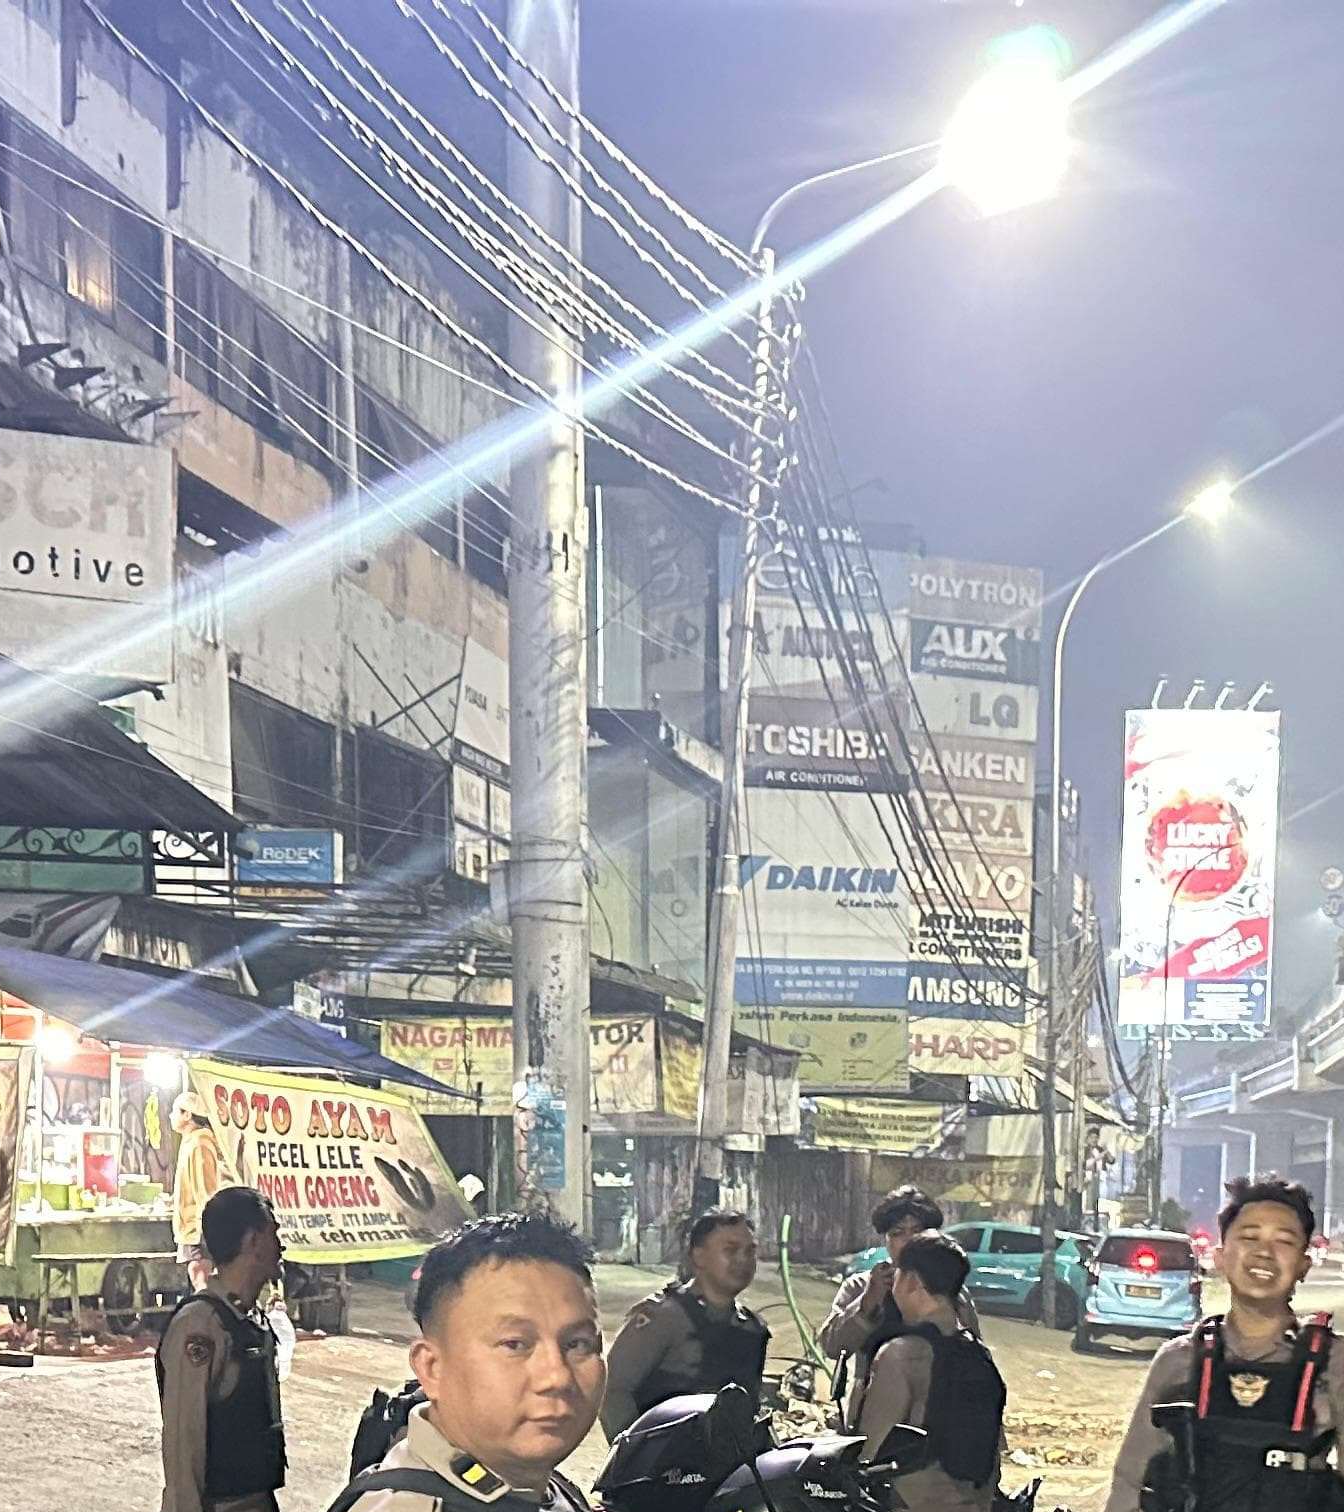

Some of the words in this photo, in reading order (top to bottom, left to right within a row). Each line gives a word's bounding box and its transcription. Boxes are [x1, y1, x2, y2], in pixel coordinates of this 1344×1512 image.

[921, 623, 1008, 661] AUX
[969, 692, 1019, 729] LG
[746, 723, 889, 761] TOSHIBA
[765, 769, 786, 782] AIR
[1167, 823, 1233, 848] LUCKY
[766, 865, 898, 893] DAIKIN
[908, 976, 1021, 1008] AMSUNG
[389, 1025, 467, 1048] NAGA
[590, 1021, 645, 1046] TOR
[909, 1033, 1017, 1060] HARP
[214, 1084, 293, 1137] SOTO
[306, 1099, 398, 1145] AYAM
[257, 1140, 309, 1169] PECEL
[316, 1144, 364, 1170] LELE
[304, 1175, 380, 1208] GORENG
[321, 1229, 356, 1243] teh
